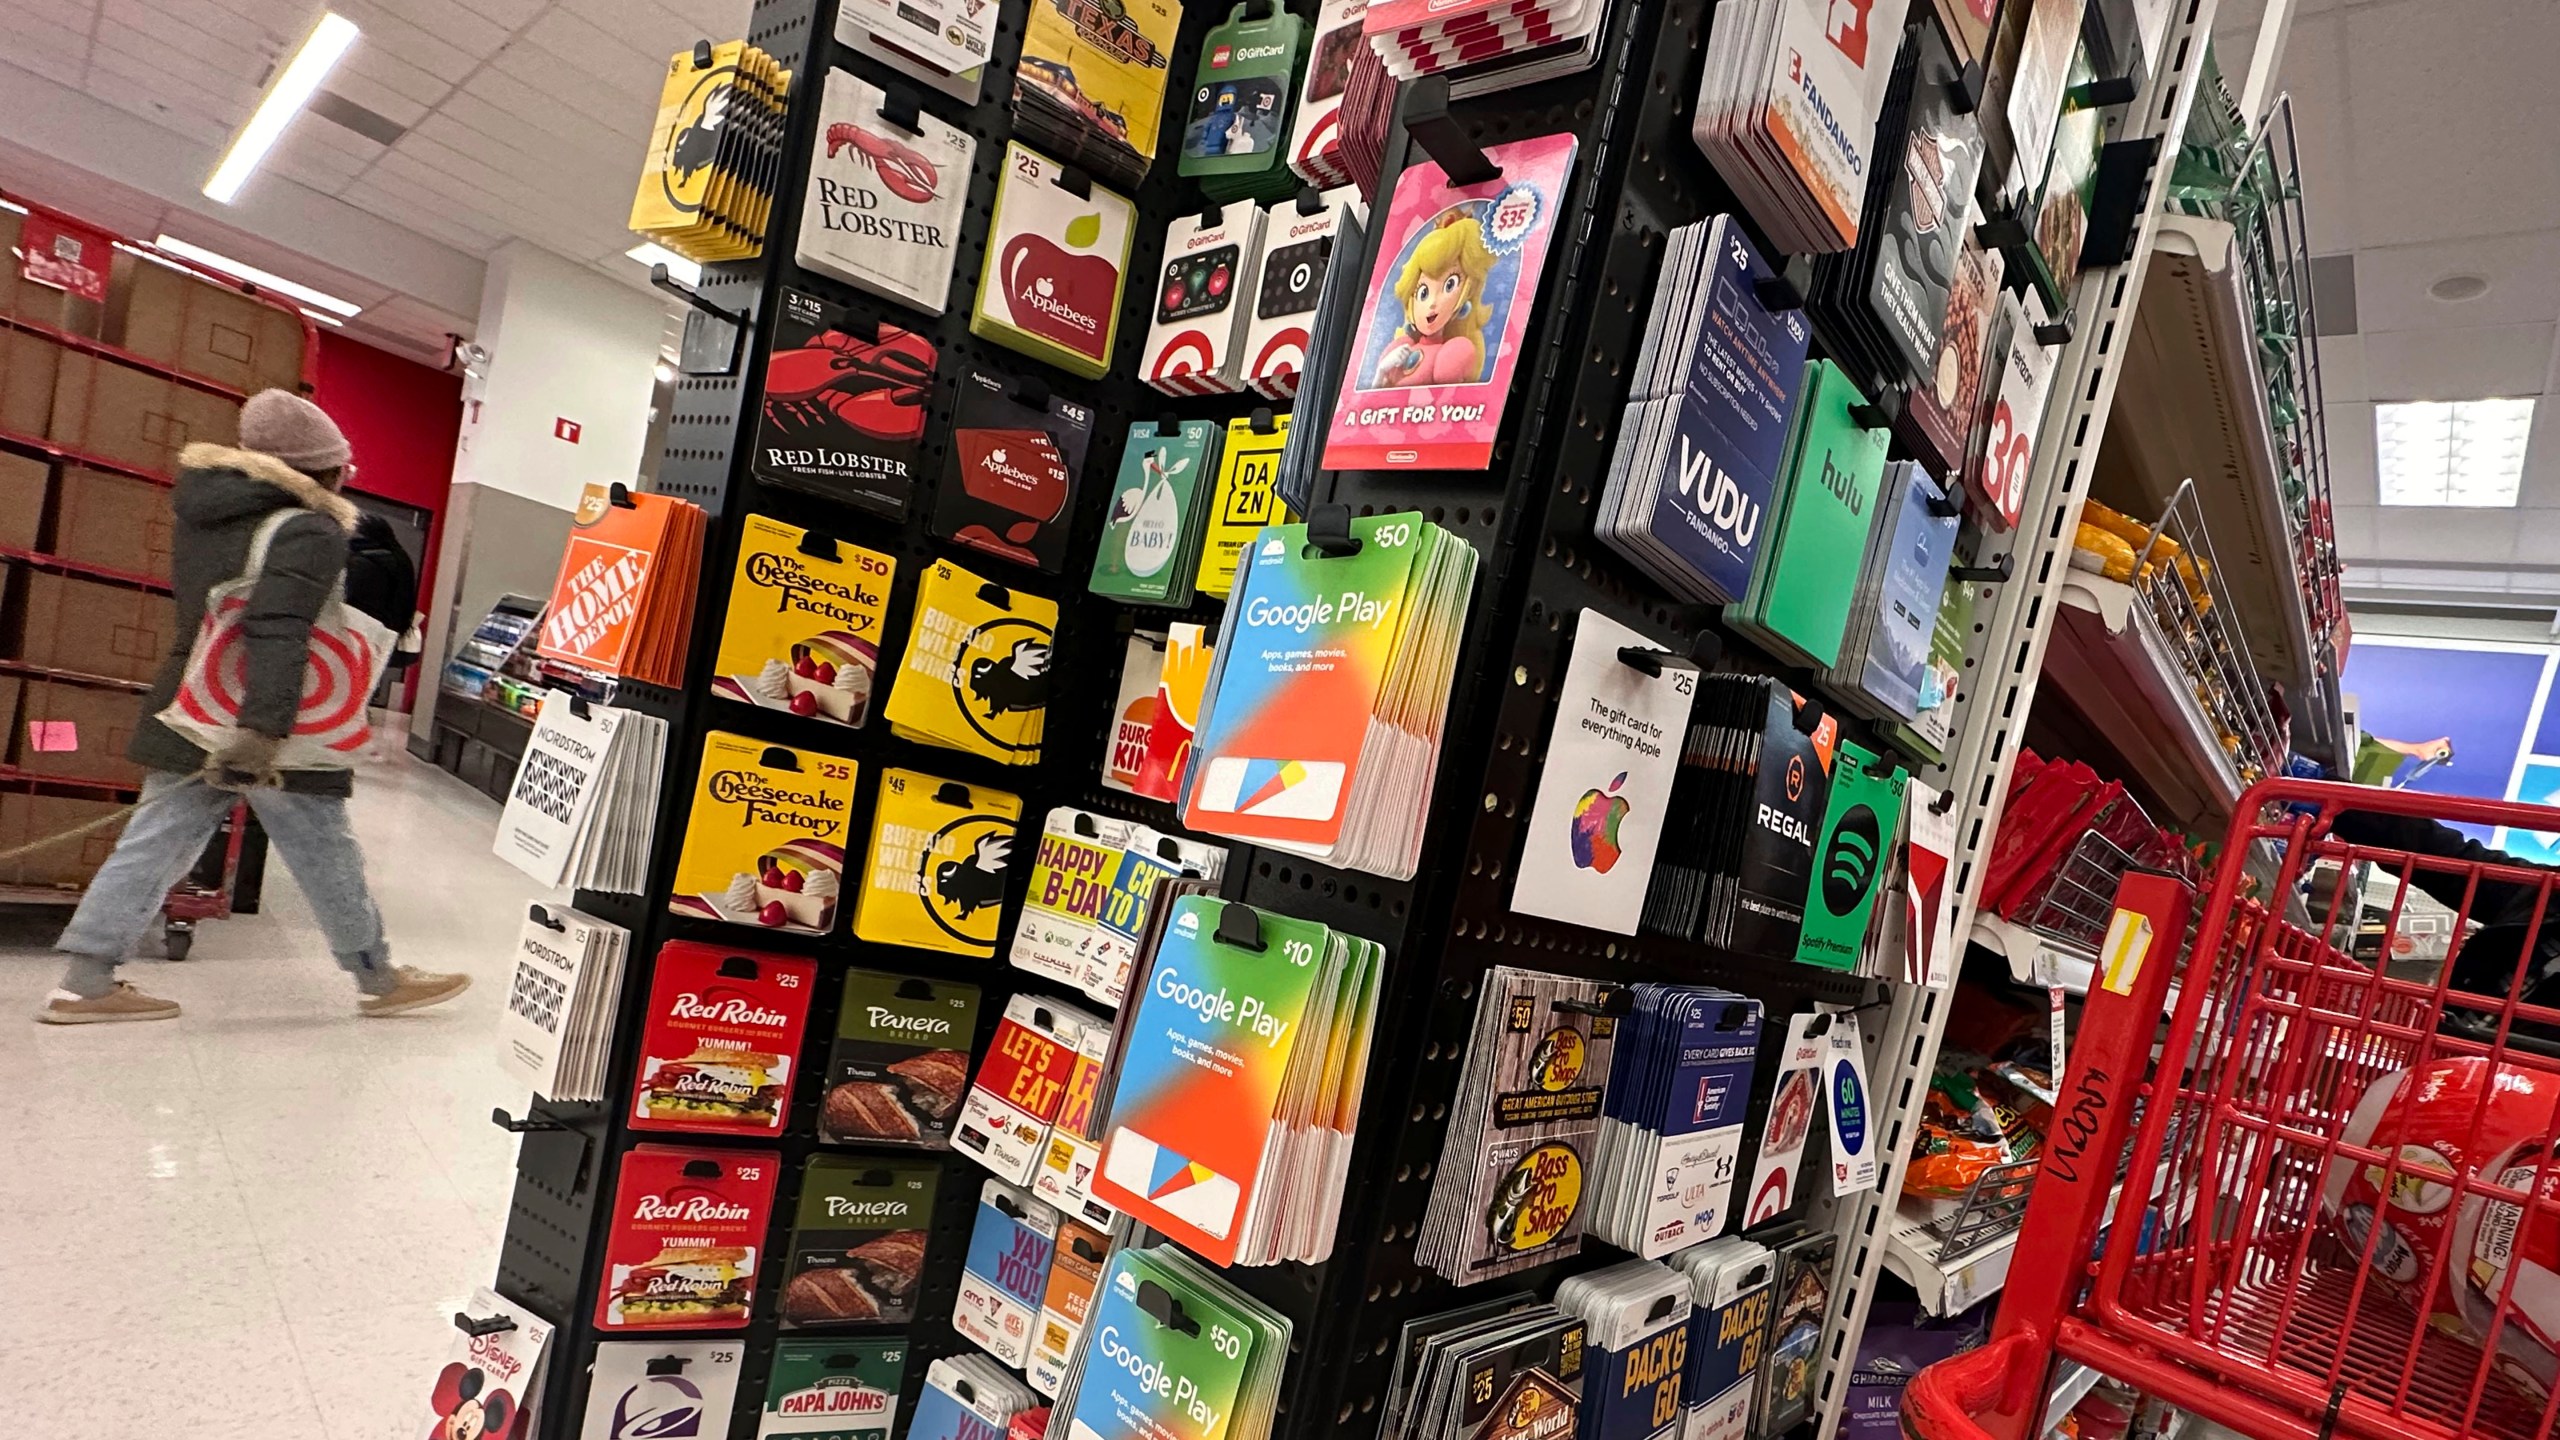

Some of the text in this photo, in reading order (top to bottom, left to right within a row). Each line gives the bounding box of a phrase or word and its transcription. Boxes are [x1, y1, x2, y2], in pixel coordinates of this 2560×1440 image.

[1066, 0, 1151, 61] TEXAS
[1246, 44, 1285, 60] GiftCard
[1802, 72, 1862, 177] FANDANGO
[945, 131, 966, 149] $25
[1015, 151, 1040, 179] $25
[817, 177, 878, 211] RED
[820, 200, 944, 249] LOBSTER
[1298, 218, 1332, 236] GiftCard
[1498, 208, 1527, 231] $35
[1195, 230, 1226, 246] GiftCard
[1729, 234, 1749, 271] $25
[1020, 285, 1098, 330] Applebee's
[1884, 261, 1937, 351] GIVE THEM WHAT
[1711, 308, 1758, 371] WATCH ANYTIME
[1703, 343, 1746, 397] TO RENT OR BUY
[1706, 331, 1783, 424] THE LATEST MOVIES SHOWS
[1062, 404, 1086, 421] $45
[1345, 403, 1486, 426] A GIFT FOR YOU!
[1187, 427, 1203, 440] $50
[766, 447, 909, 477] RED LOBSTER
[981, 455, 1039, 485] Applebee's
[1048, 467, 1065, 481] $15
[1243, 462, 1269, 486] DA
[1982, 399, 2033, 530] 30
[1679, 432, 1760, 547] VUDU
[1820, 447, 1864, 517] hulu
[583, 494, 605, 513] $25
[1237, 491, 1263, 514] ZN
[1130, 531, 1173, 549] BABY!
[1373, 523, 1410, 549] $50
[1685, 509, 1729, 555] FANDANGO
[567, 553, 607, 596] THE
[781, 554, 806, 573] The
[854, 553, 889, 578] $50
[936, 564, 953, 581] $25
[745, 551, 880, 608] Cheesecake
[548, 550, 646, 650] HOME
[772, 579, 875, 632] Factory
[1246, 591, 1393, 634] Google Play
[571, 592, 634, 656] DEPOT
[921, 605, 995, 654] BUFFALO
[1260, 647, 1348, 660] Apps, games, movies,
[909, 649, 968, 689] WINGS
[1268, 662, 1335, 673] books, and more
[1672, 671, 1693, 697] $25
[1590, 697, 1662, 740] The gift card for
[537, 725, 597, 765] NORDSTROM
[1581, 717, 1662, 758] everything Apple
[744, 771, 769, 786] The
[818, 761, 851, 781] $25
[888, 776, 906, 793] $45
[1790, 771, 1801, 788] R
[708, 769, 845, 812] Cheesecake
[1890, 776, 1904, 798] $30
[736, 795, 841, 838] Factory
[1756, 802, 1813, 847] REGAL
[880, 822, 957, 858] BUFFALO
[1036, 837, 1109, 881] HAPPY
[874, 866, 933, 897] WINGS
[1105, 888, 1135, 927] TO
[523, 936, 575, 976] NORDSTROM
[1283, 939, 1314, 968] $10
[775, 972, 800, 989] $25
[670, 992, 788, 1028] Red Robin
[866, 1006, 950, 1034] Panera
[1156, 966, 1289, 1048] Google Play
[1510, 1006, 1532, 1031] $50
[697, 1036, 752, 1052] YUMMM!
[889, 1030, 929, 1041] BREAD
[1166, 1027, 1246, 1069] Apps, games, movies,
[1554, 1031, 1577, 1051] Bass
[1001, 1026, 1056, 1073] LET'S
[1171, 1045, 1234, 1078] books, and more
[1554, 1050, 1570, 1066] Pro
[1683, 1047, 1735, 1061] EVERY CARD GIVES
[675, 1074, 752, 1096] Red Robin
[1549, 1063, 1577, 1084] Shops
[1502, 1094, 1556, 1113] GREAT AMERICAN
[1840, 1076, 1856, 1106] 60
[1489, 1150, 1499, 1169] 3
[1532, 1151, 1570, 1183] Bass
[736, 1167, 761, 1181] $25
[1532, 1179, 1558, 1206] Pro
[1684, 1183, 1706, 1202] ULTA
[634, 1195, 750, 1222] Red Robin
[824, 1196, 909, 1217] Panera
[1693, 1208, 1715, 1227] IHOP
[1523, 1203, 1570, 1238] Shops
[1654, 1225, 1685, 1243] OUTBACK
[661, 1236, 717, 1248] YUMMM!
[1013, 1226, 1049, 1270] YAY
[646, 1276, 723, 1294] Red Robin
[995, 1251, 1044, 1306] YOU!
[963, 1289, 985, 1307] amc
[528, 1325, 545, 1344] $25
[1209, 1323, 1241, 1360] $50
[709, 1351, 734, 1364] $25
[881, 1350, 901, 1363] $25
[994, 1341, 1018, 1364] rack
[1737, 1328, 1763, 1377] GO
[470, 1354, 506, 1380] GIFT CARD
[1036, 1367, 1057, 1387] IHOP
[827, 1377, 852, 1388] PIZZA
[1100, 1325, 1221, 1438] Google Play
[1473, 1376, 1494, 1405] $25
[783, 1390, 886, 1414] PAPA JOHN'S
[1652, 1372, 1683, 1429] GO
[1867, 1395, 1892, 1409] MILK
[1532, 1404, 1570, 1439] World
